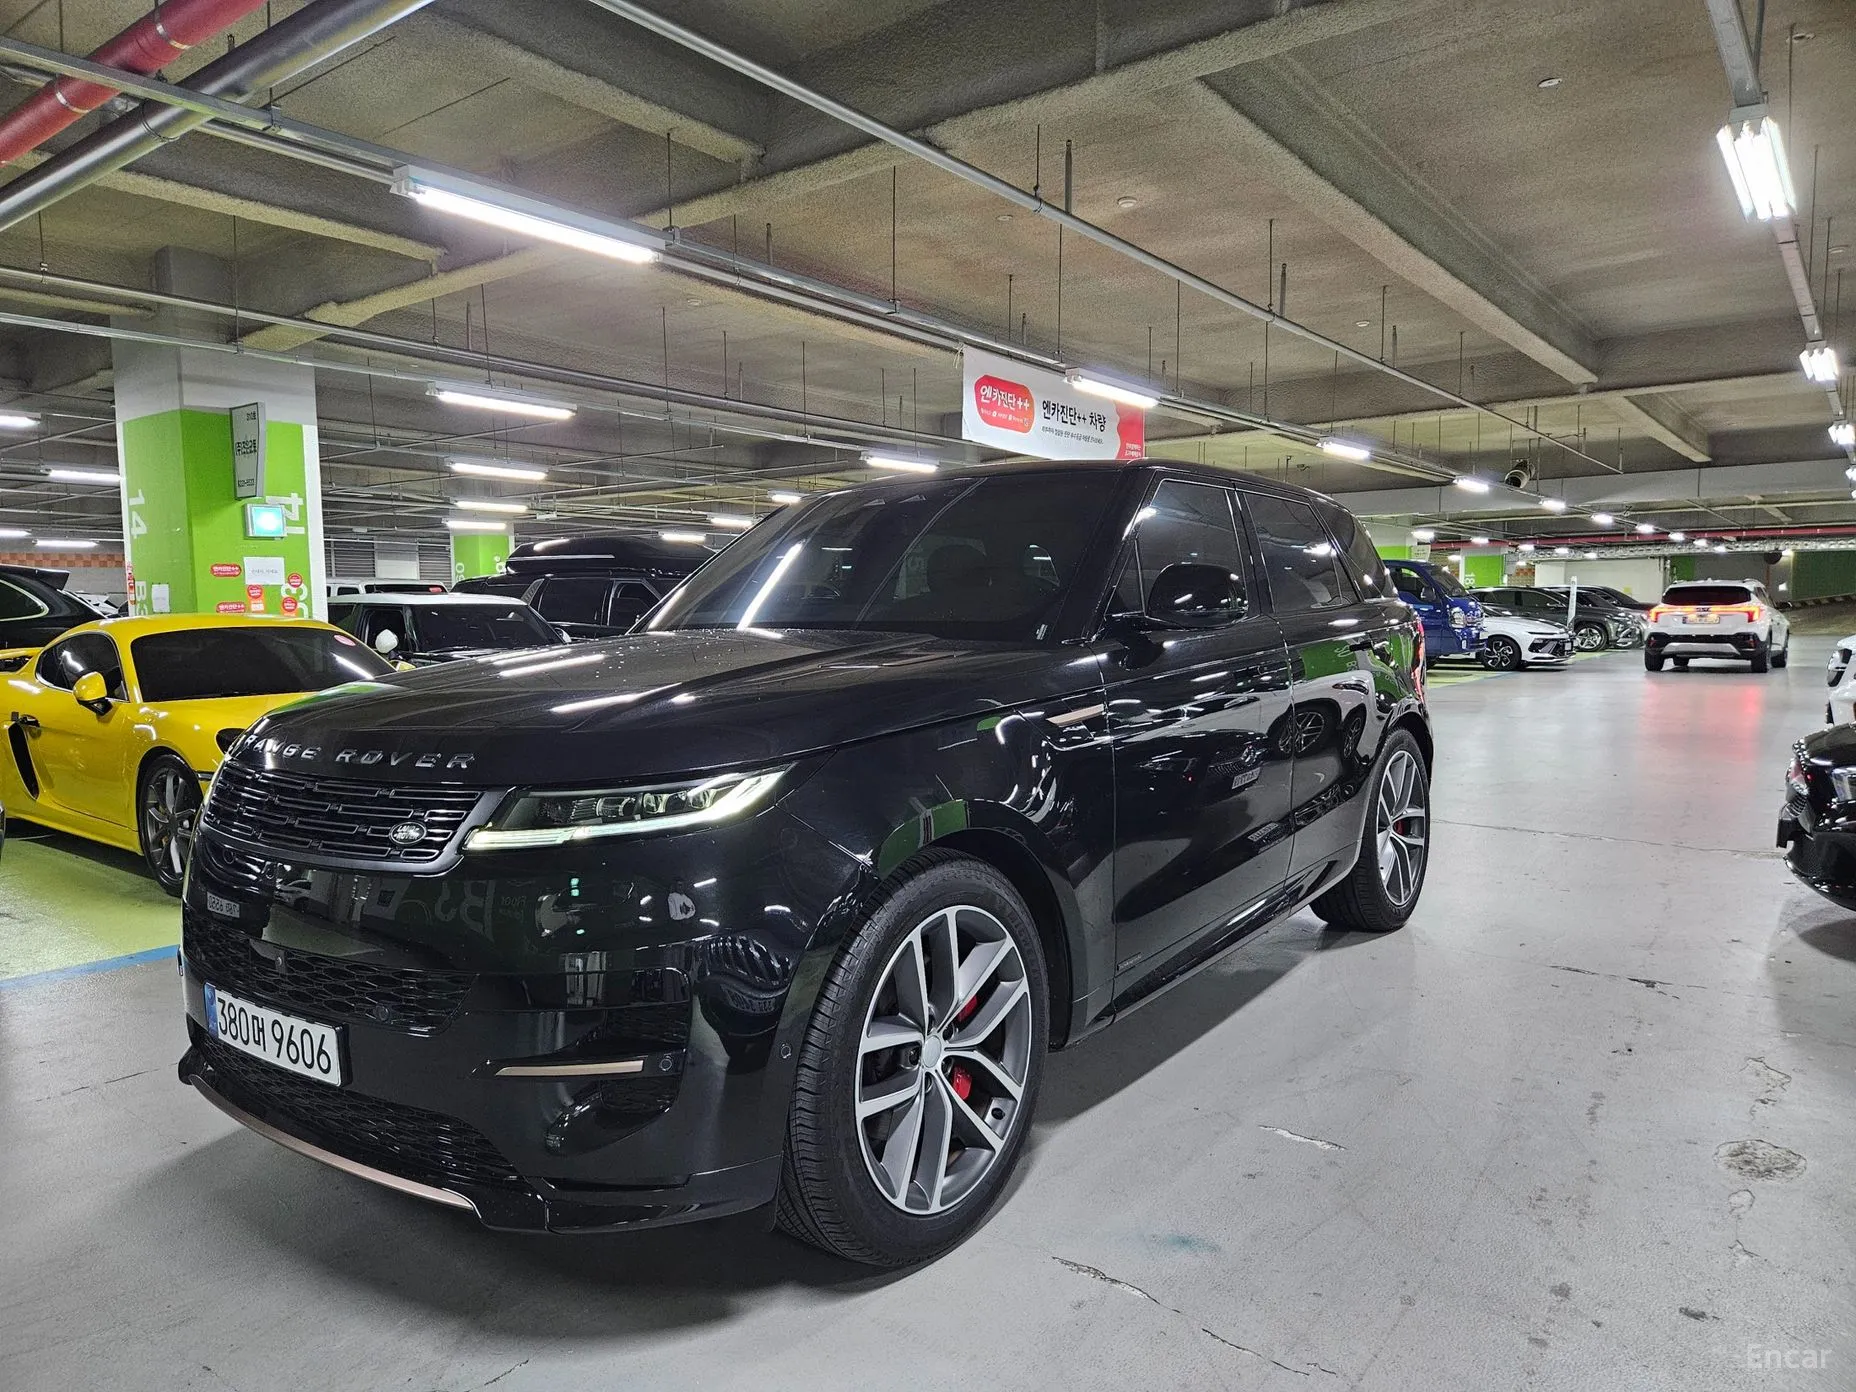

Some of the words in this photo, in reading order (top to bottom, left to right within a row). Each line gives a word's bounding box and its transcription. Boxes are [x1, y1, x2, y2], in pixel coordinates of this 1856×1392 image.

[980, 385, 1030, 411] 엔카진단++
[1042, 400, 1087, 426] 엔카진단++
[1089, 411, 1106, 432] 차량
[245, 734, 323, 760] RANGE
[335, 749, 476, 769] ROVER
[396, 831, 420, 841] ROVER
[397, 825, 417, 833] LAND
[217, 997, 267, 1052] 380머
[271, 1019, 331, 1075] 9606
